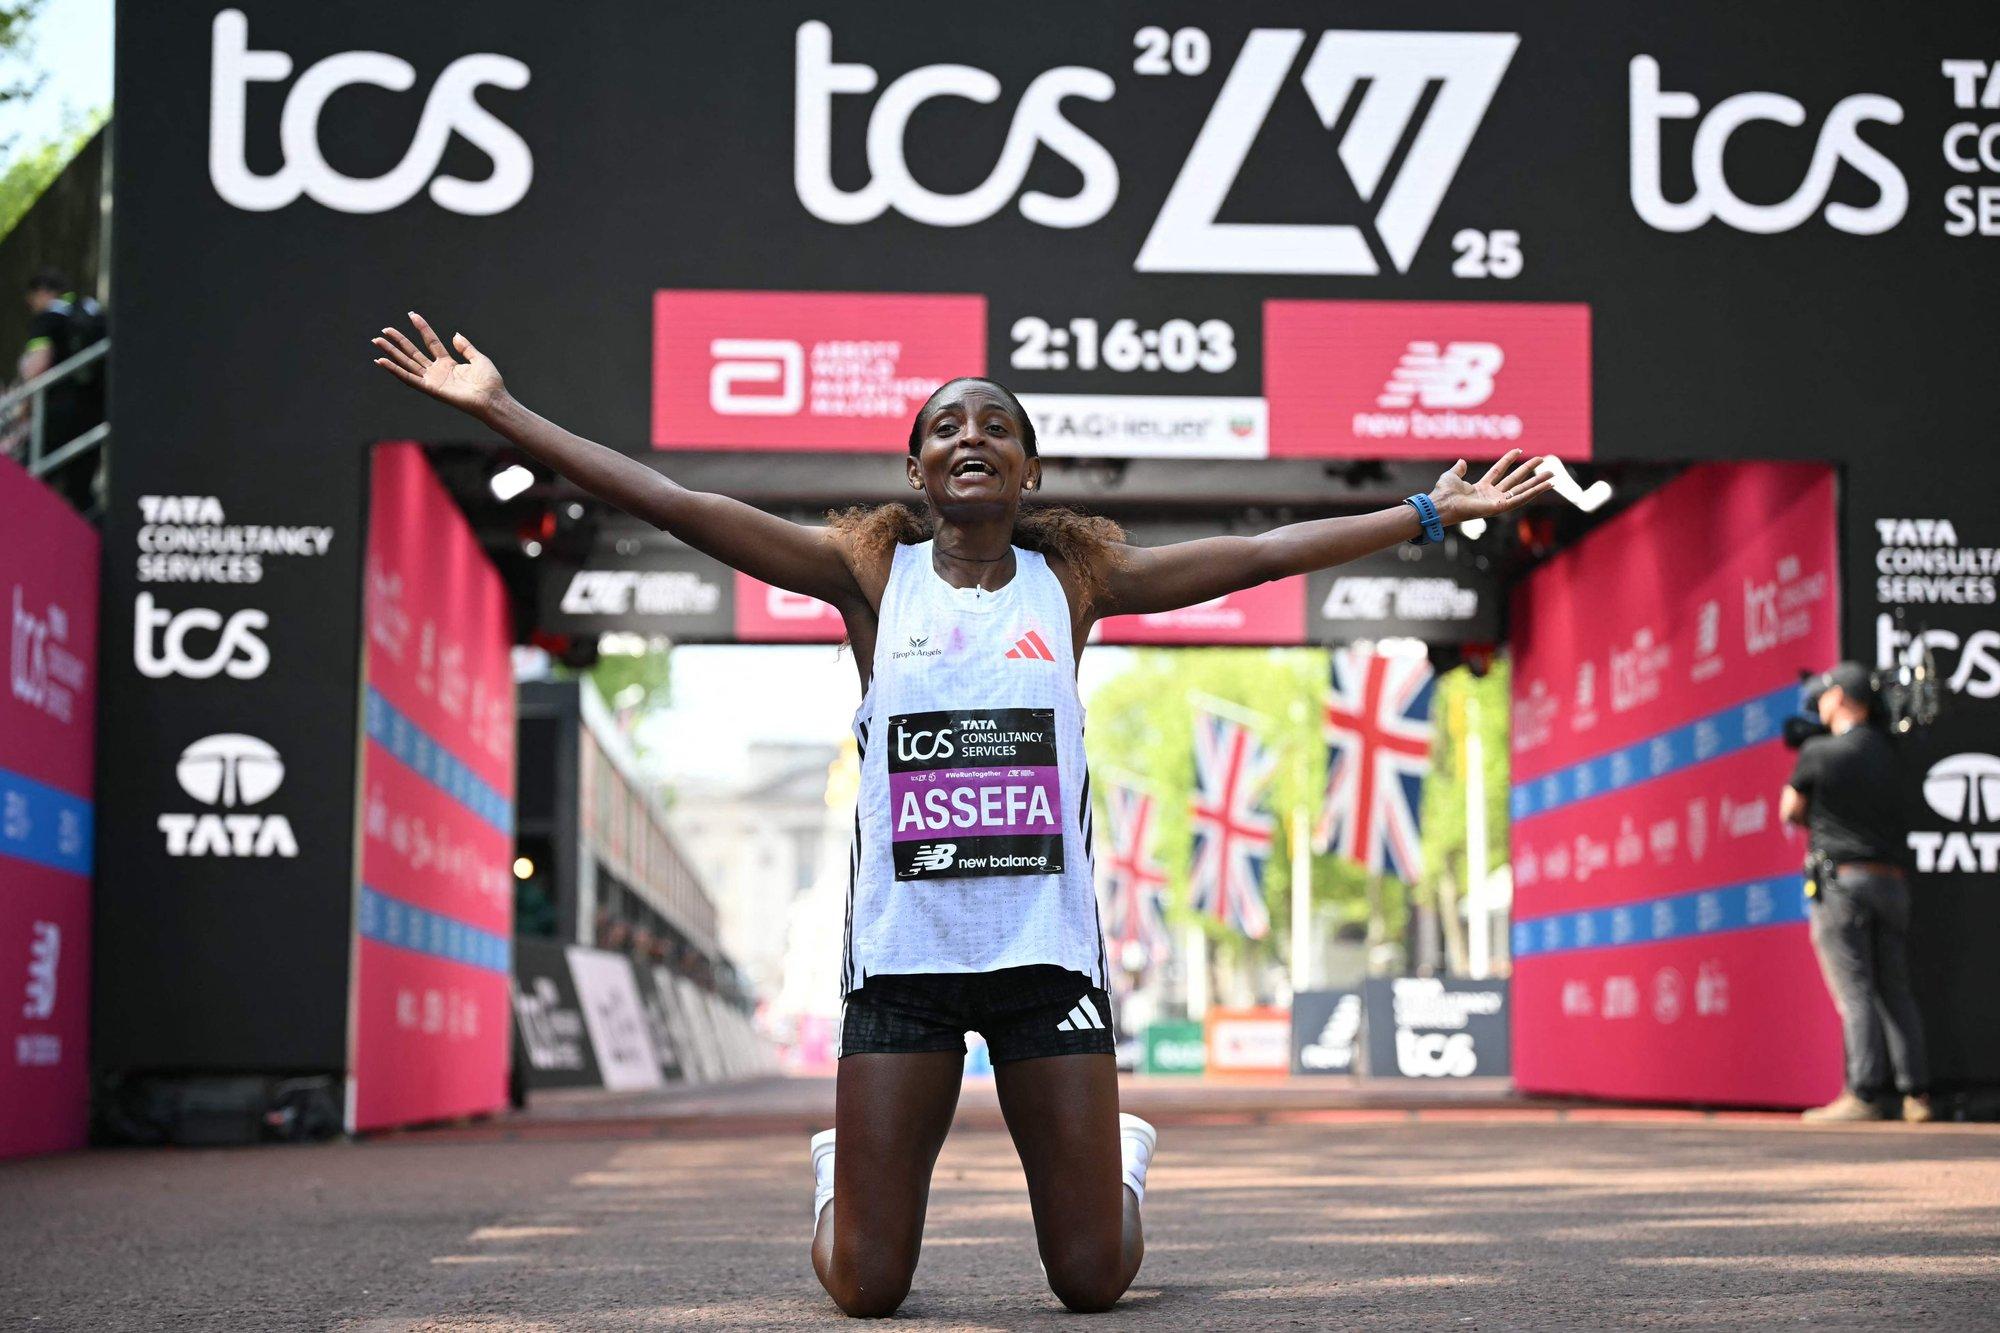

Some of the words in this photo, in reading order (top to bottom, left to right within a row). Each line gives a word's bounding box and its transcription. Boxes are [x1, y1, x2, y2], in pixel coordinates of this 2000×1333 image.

[1134, 27, 1210, 75] 20
[210, 9, 532, 215] tcs
[795, 21, 1119, 228] tcs
[1630, 55, 1908, 234] tcs
[1453, 229, 1523, 278] 25
[1010, 316, 1237, 373] 2:16:03
[1353, 412, 1408, 437] new
[1411, 410, 1523, 440] balance
[139, 496, 224, 524] TATA
[138, 525, 334, 555] CONSULTANCY
[1876, 518, 1957, 546] TATA
[138, 554, 263, 583] SERVICES
[1877, 575, 1996, 604] SERVICES
[135, 592, 270, 679] tcs
[892, 650, 915, 659] Tirop's
[916, 649, 942, 657] Angels
[961, 719, 997, 730] TATA
[961, 732, 1043, 744] CONSULTANCY
[898, 726, 954, 761] tcs
[962, 745, 1017, 757] SERVICES
[945, 770, 1001, 779] #WeRunTogether
[898, 785, 1055, 832] ASSEFA
[157, 813, 299, 857] TATA
[958, 856, 987, 869] new
[990, 853, 1048, 868] balance
